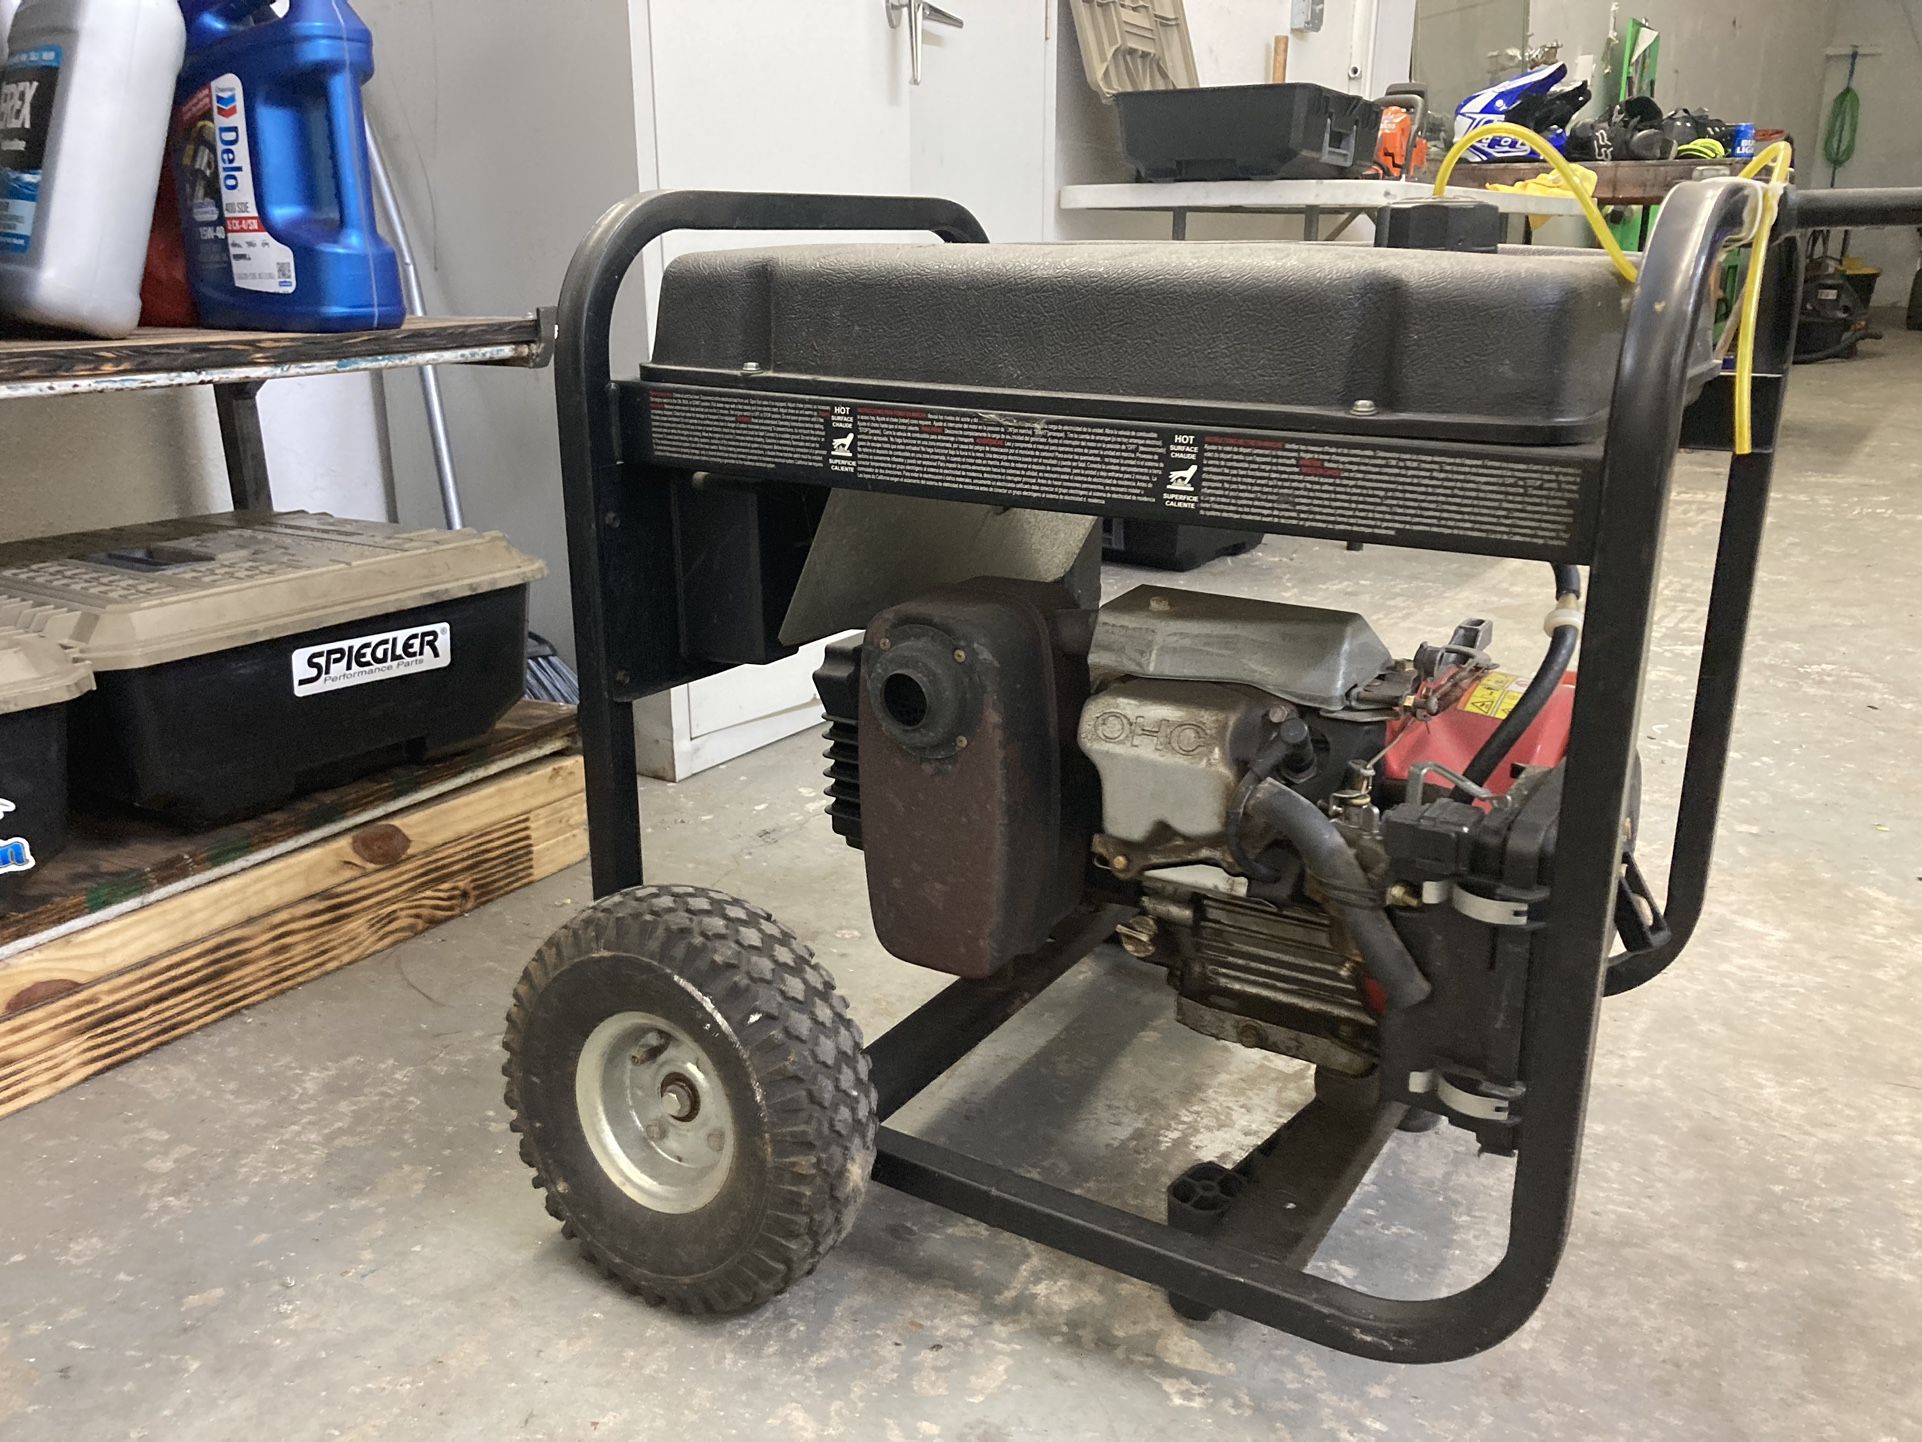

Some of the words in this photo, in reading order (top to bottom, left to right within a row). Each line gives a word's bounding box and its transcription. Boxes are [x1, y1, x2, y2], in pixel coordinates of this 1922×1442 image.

[218, 126, 243, 190] Delo
[834, 406, 851, 415] HOT
[831, 414, 854, 422] SURFACE
[1174, 434, 1195, 444] HOT
[1169, 444, 1199, 453] SURFACE
[1170, 452, 1197, 460] CHAUDE
[828, 458, 857, 467] SUPERFICIE
[830, 465, 855, 473] CALIENTE
[1162, 492, 1199, 502] SUPERFICIE
[1165, 500, 1196, 509] CALIENTE
[298, 630, 440, 686] SPIEGLER
[324, 664, 393, 684] Performance
[396, 657, 424, 669] Parts
[1094, 711, 1209, 756] OHC
